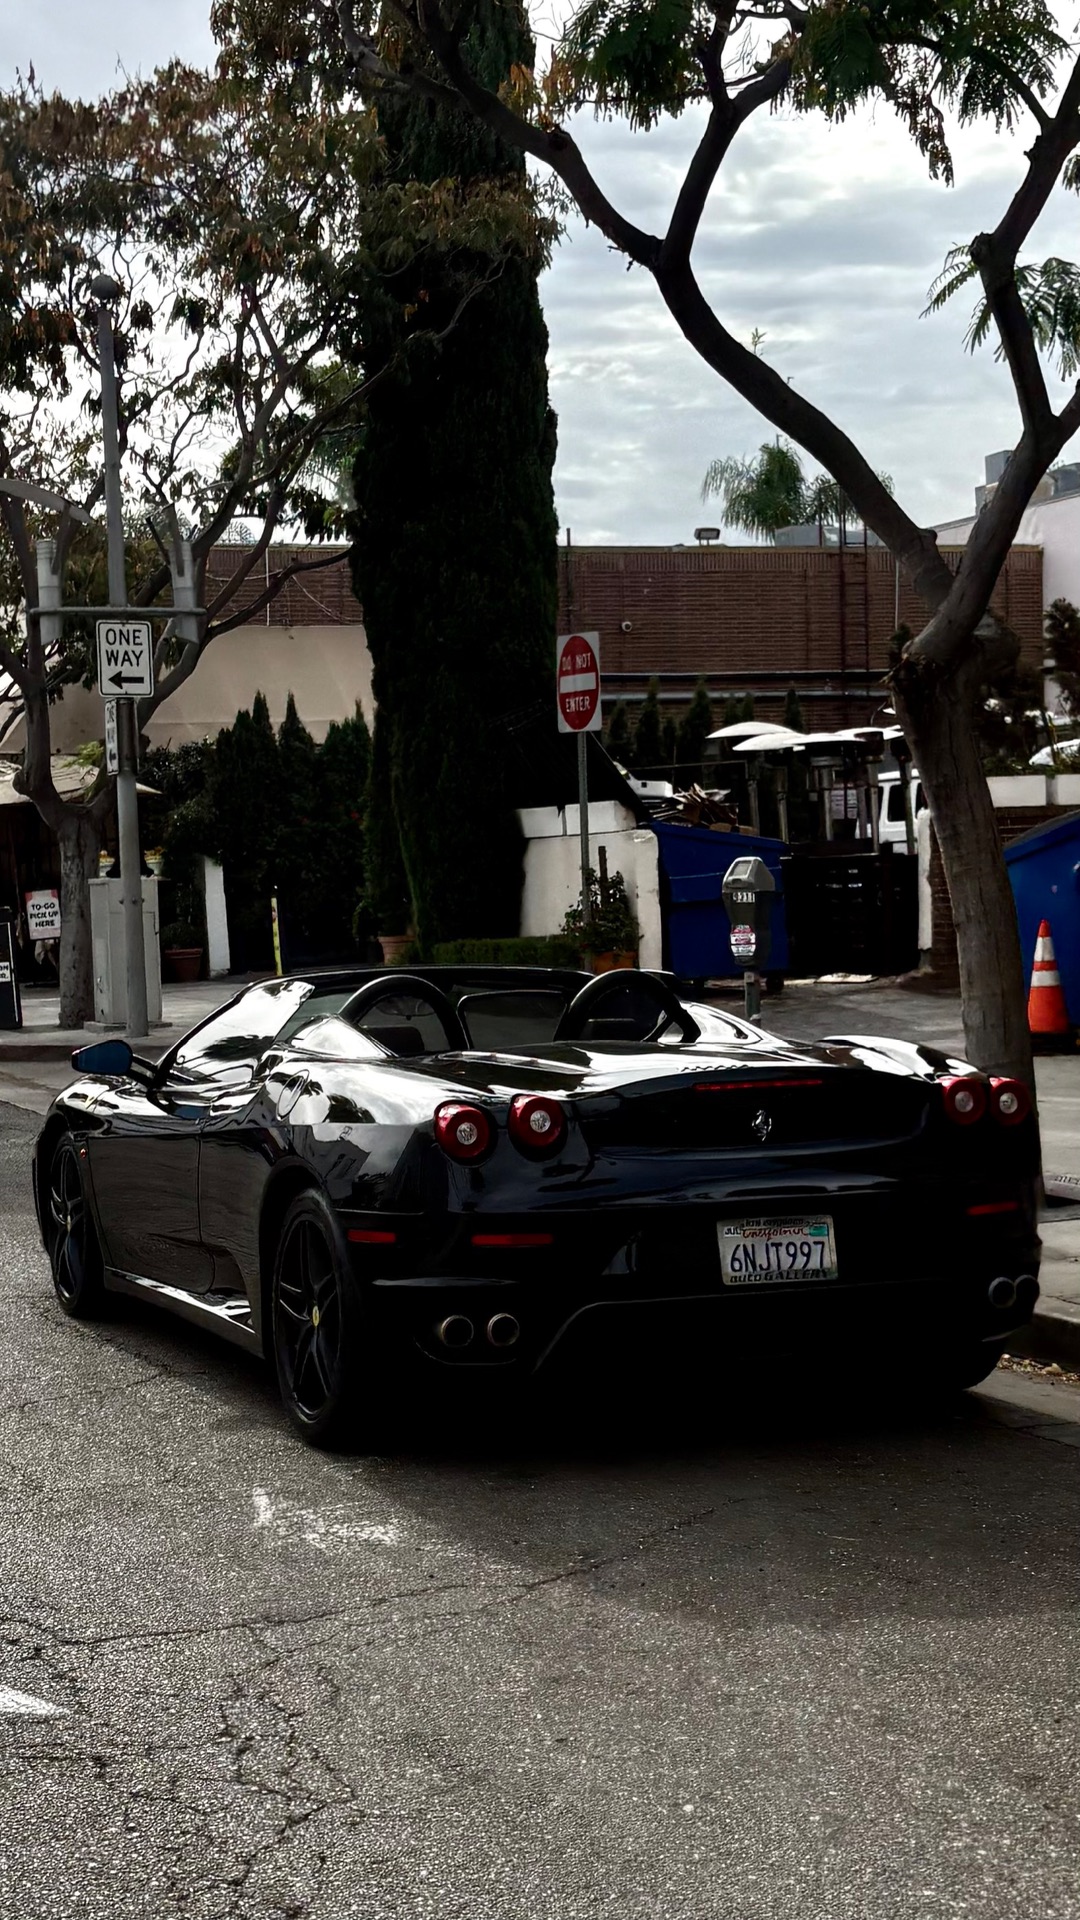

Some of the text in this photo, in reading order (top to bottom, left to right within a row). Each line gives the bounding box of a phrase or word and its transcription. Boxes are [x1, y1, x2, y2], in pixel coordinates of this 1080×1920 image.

[105, 628, 143, 646] ONE
[105, 649, 143, 667] WAY
[562, 652, 591, 671] DO NOT
[565, 696, 591, 712] ENTER
[29, 910, 59, 919] PICK UP
[35, 919, 55, 928] HERE
[724, 1226, 742, 1236] JUL
[730, 1241, 826, 1273] 6NJT997
[764, 1268, 829, 1281] GALLERY
